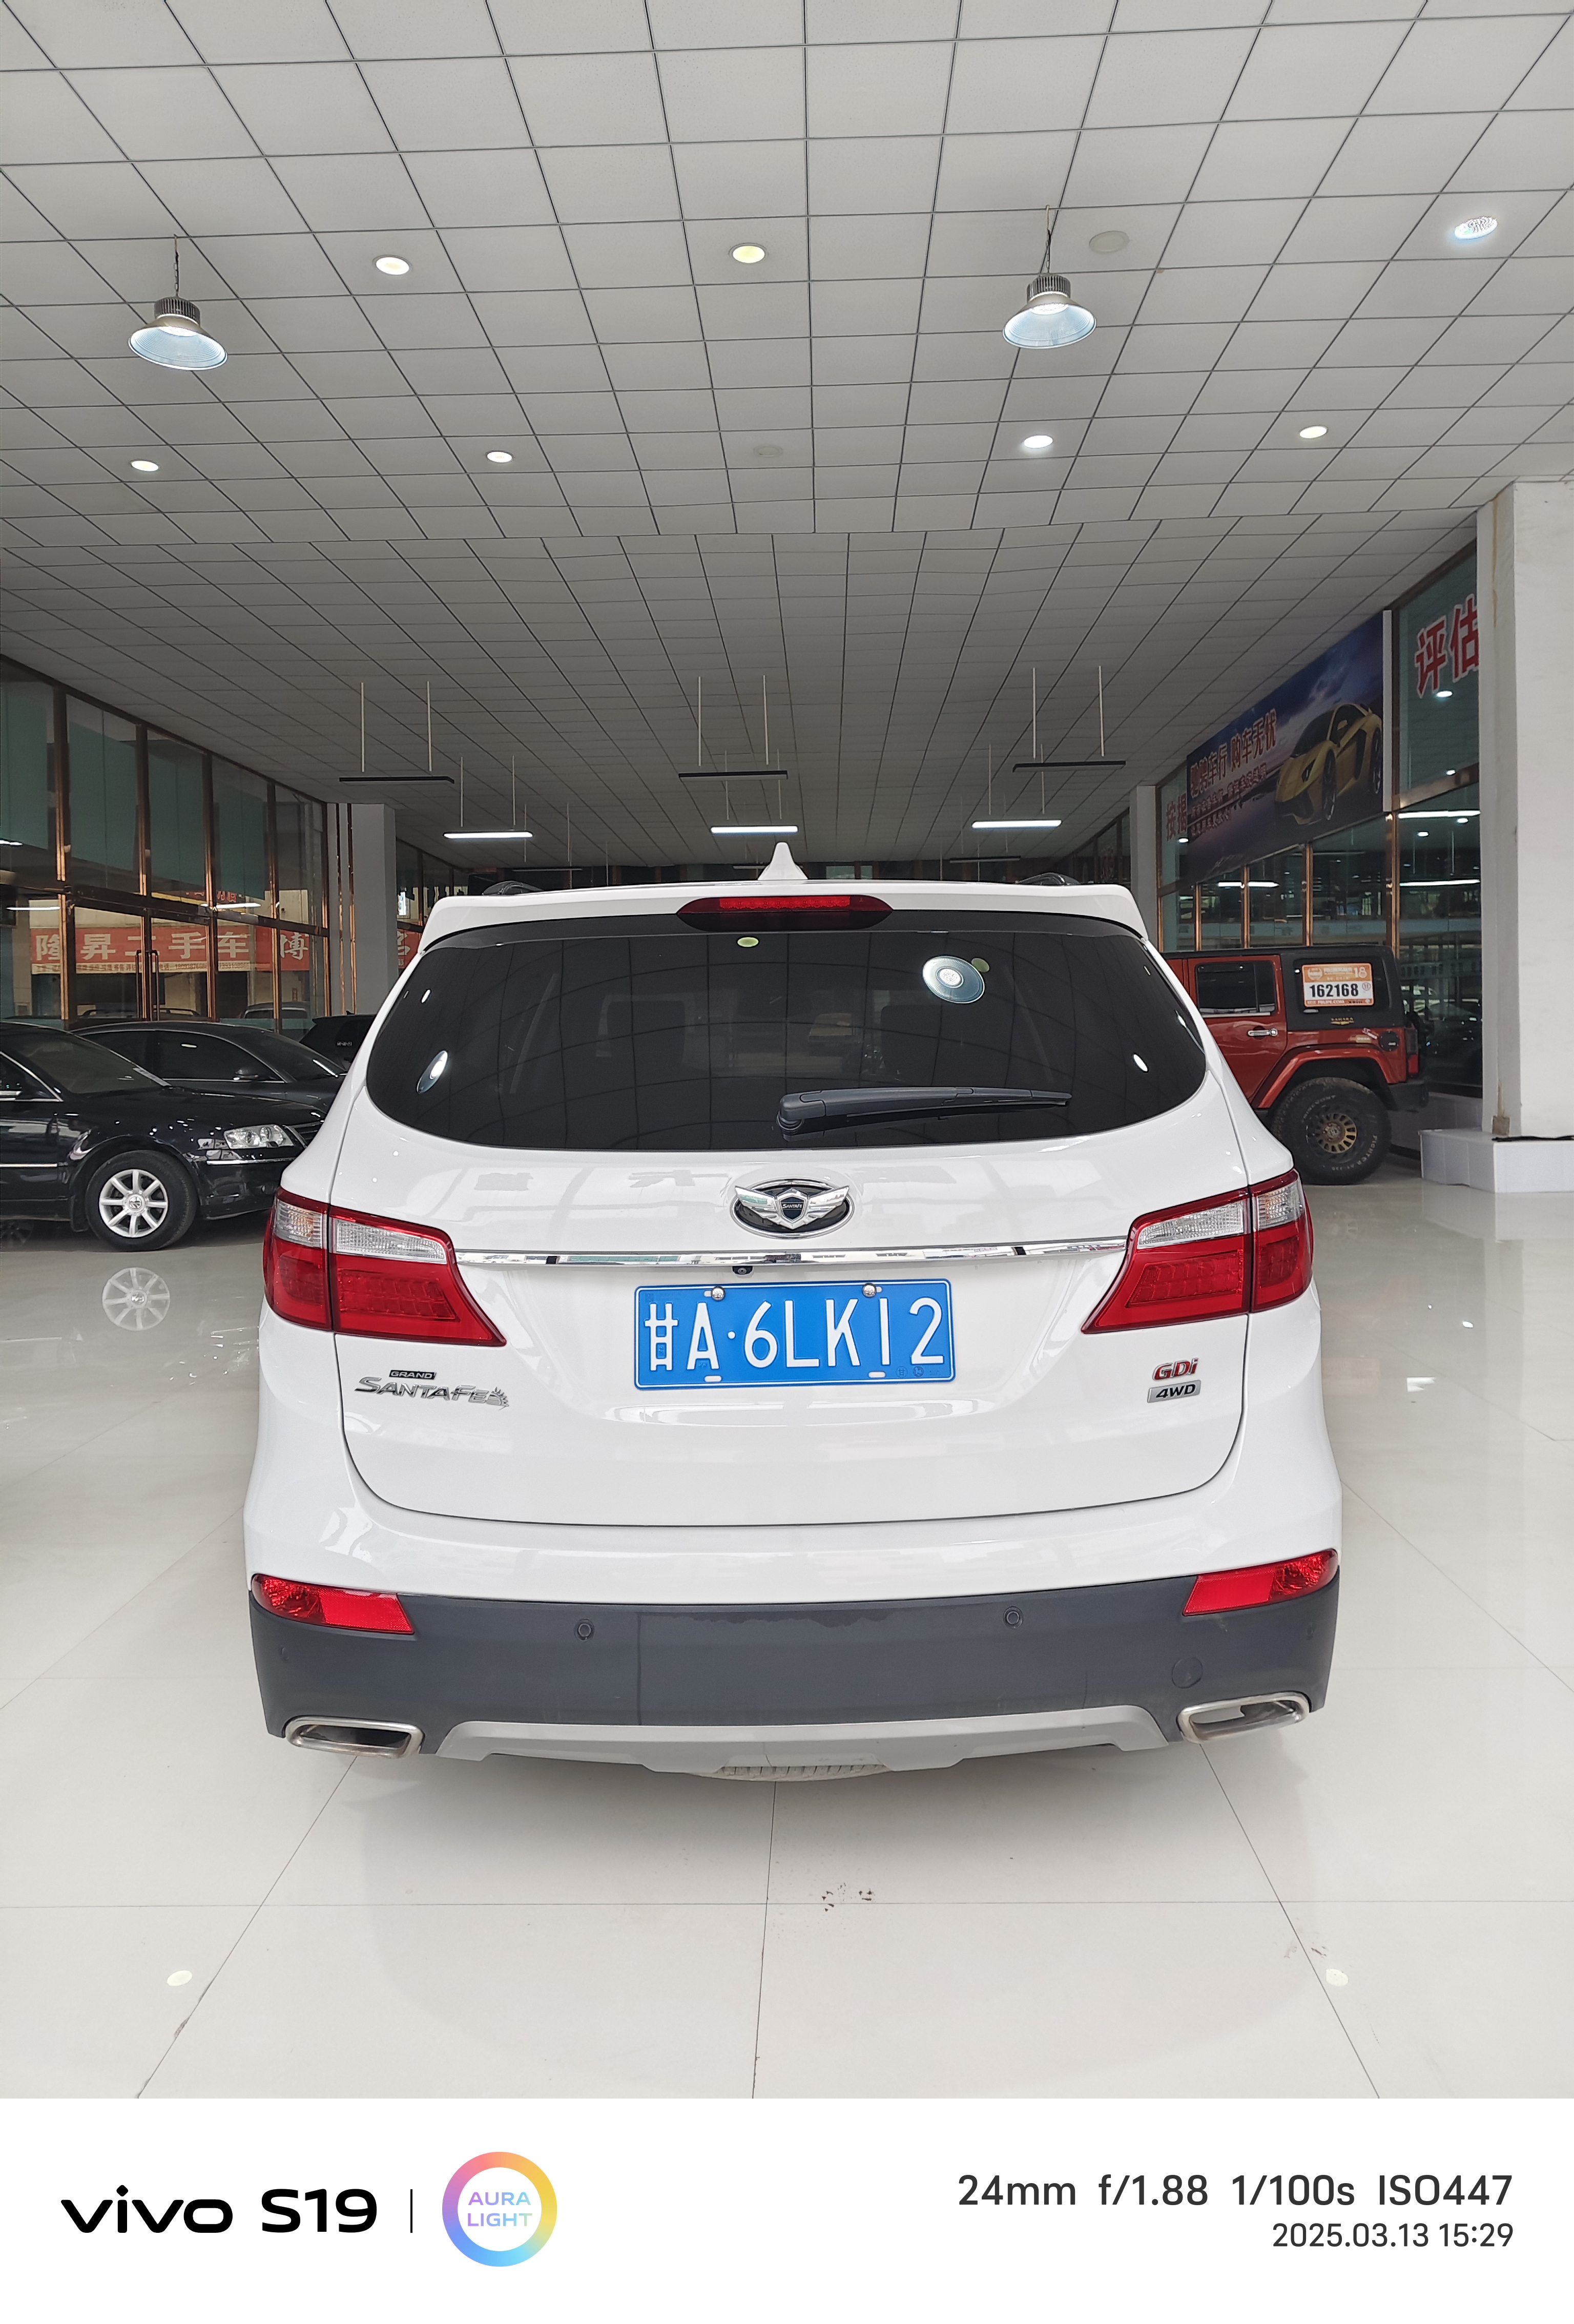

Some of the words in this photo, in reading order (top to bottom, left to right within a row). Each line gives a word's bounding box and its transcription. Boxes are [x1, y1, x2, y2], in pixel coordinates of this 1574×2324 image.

[1415, 594, 1479, 699] 评估
[1231, 708, 1277, 772] 购车无忧
[36, 931, 250, 961] 隆昇二手车
[1310, 983, 1359, 998] 162168
[645, 1297, 945, 1372] 甘A·6LK12
[1152, 1358, 1199, 1380] GDi
[1156, 1384, 1196, 1398] 4WD
